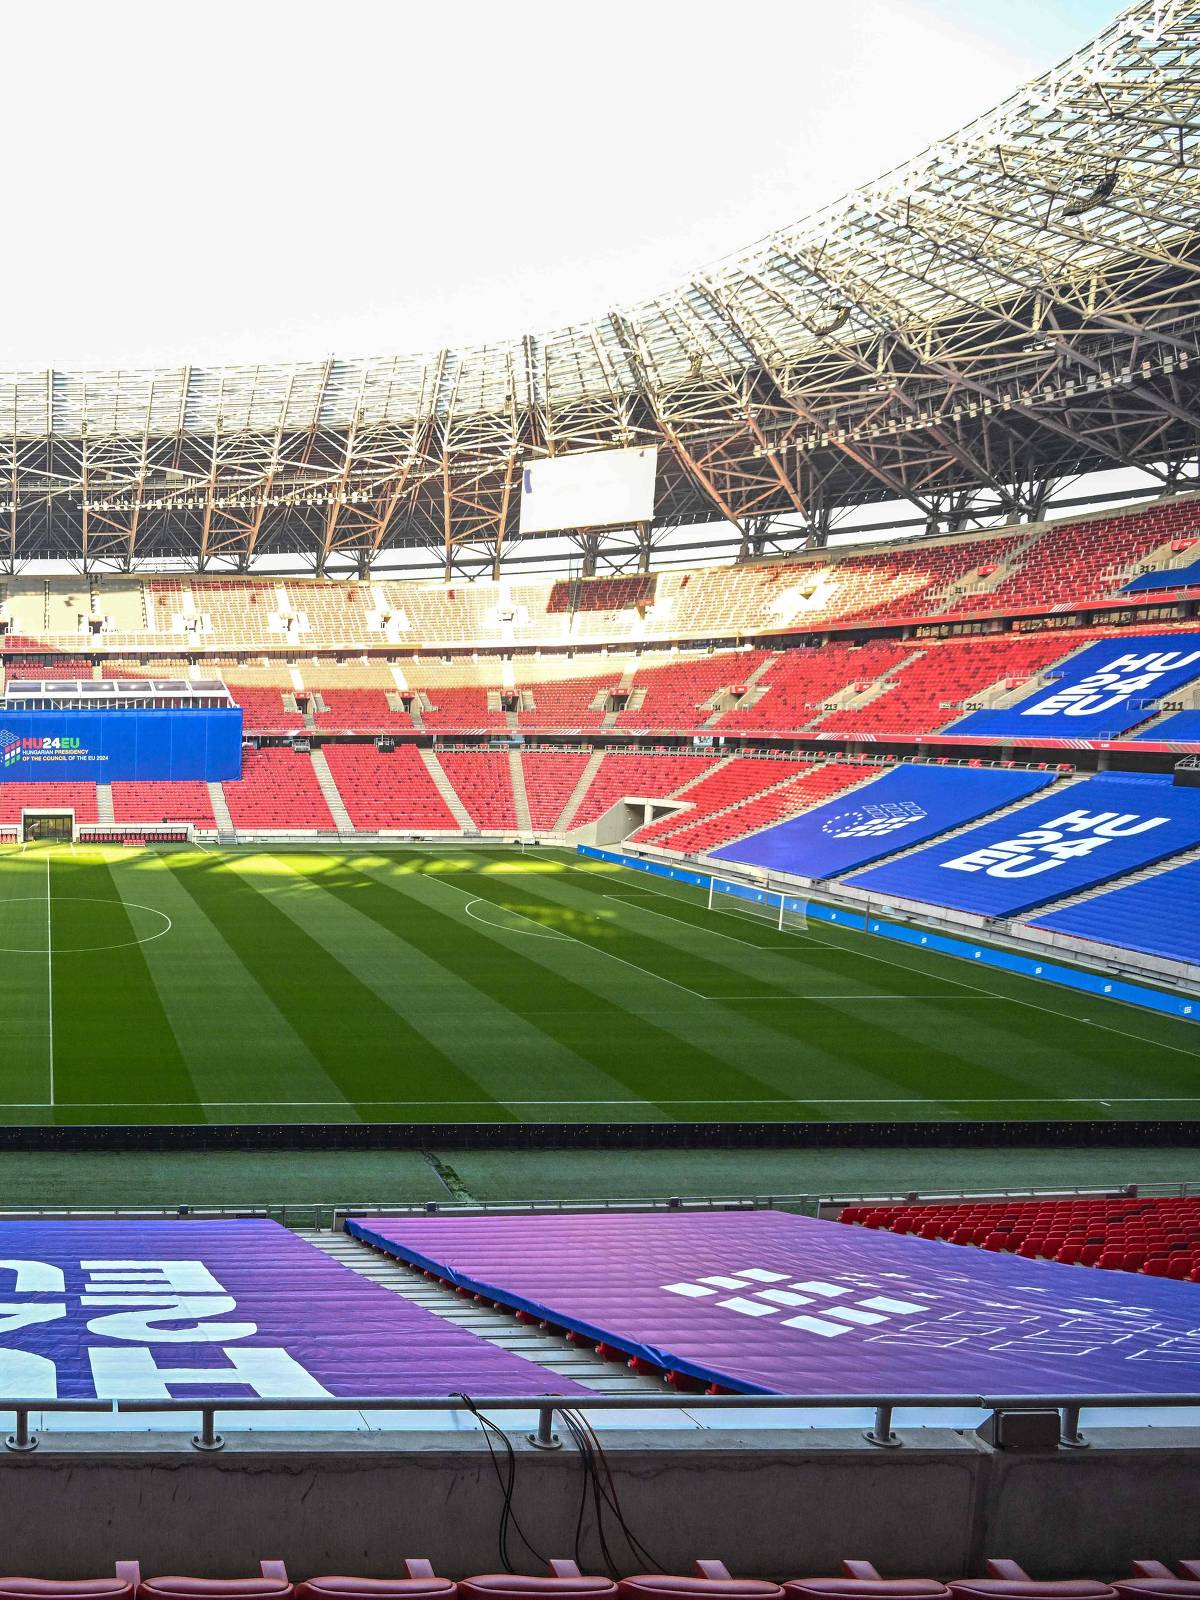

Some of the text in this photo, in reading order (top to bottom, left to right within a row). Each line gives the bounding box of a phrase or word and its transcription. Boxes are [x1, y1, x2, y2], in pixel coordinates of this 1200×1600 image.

[1096, 650, 1200, 673] HU
[1057, 672, 1165, 695] 24
[1020, 694, 1131, 716] EU
[1162, 701, 1184, 711] 211
[22, 737, 80, 749] HU24EU
[1038, 809, 1172, 837] HU
[988, 830, 1114, 860] 24
[938, 848, 1066, 878] EU
